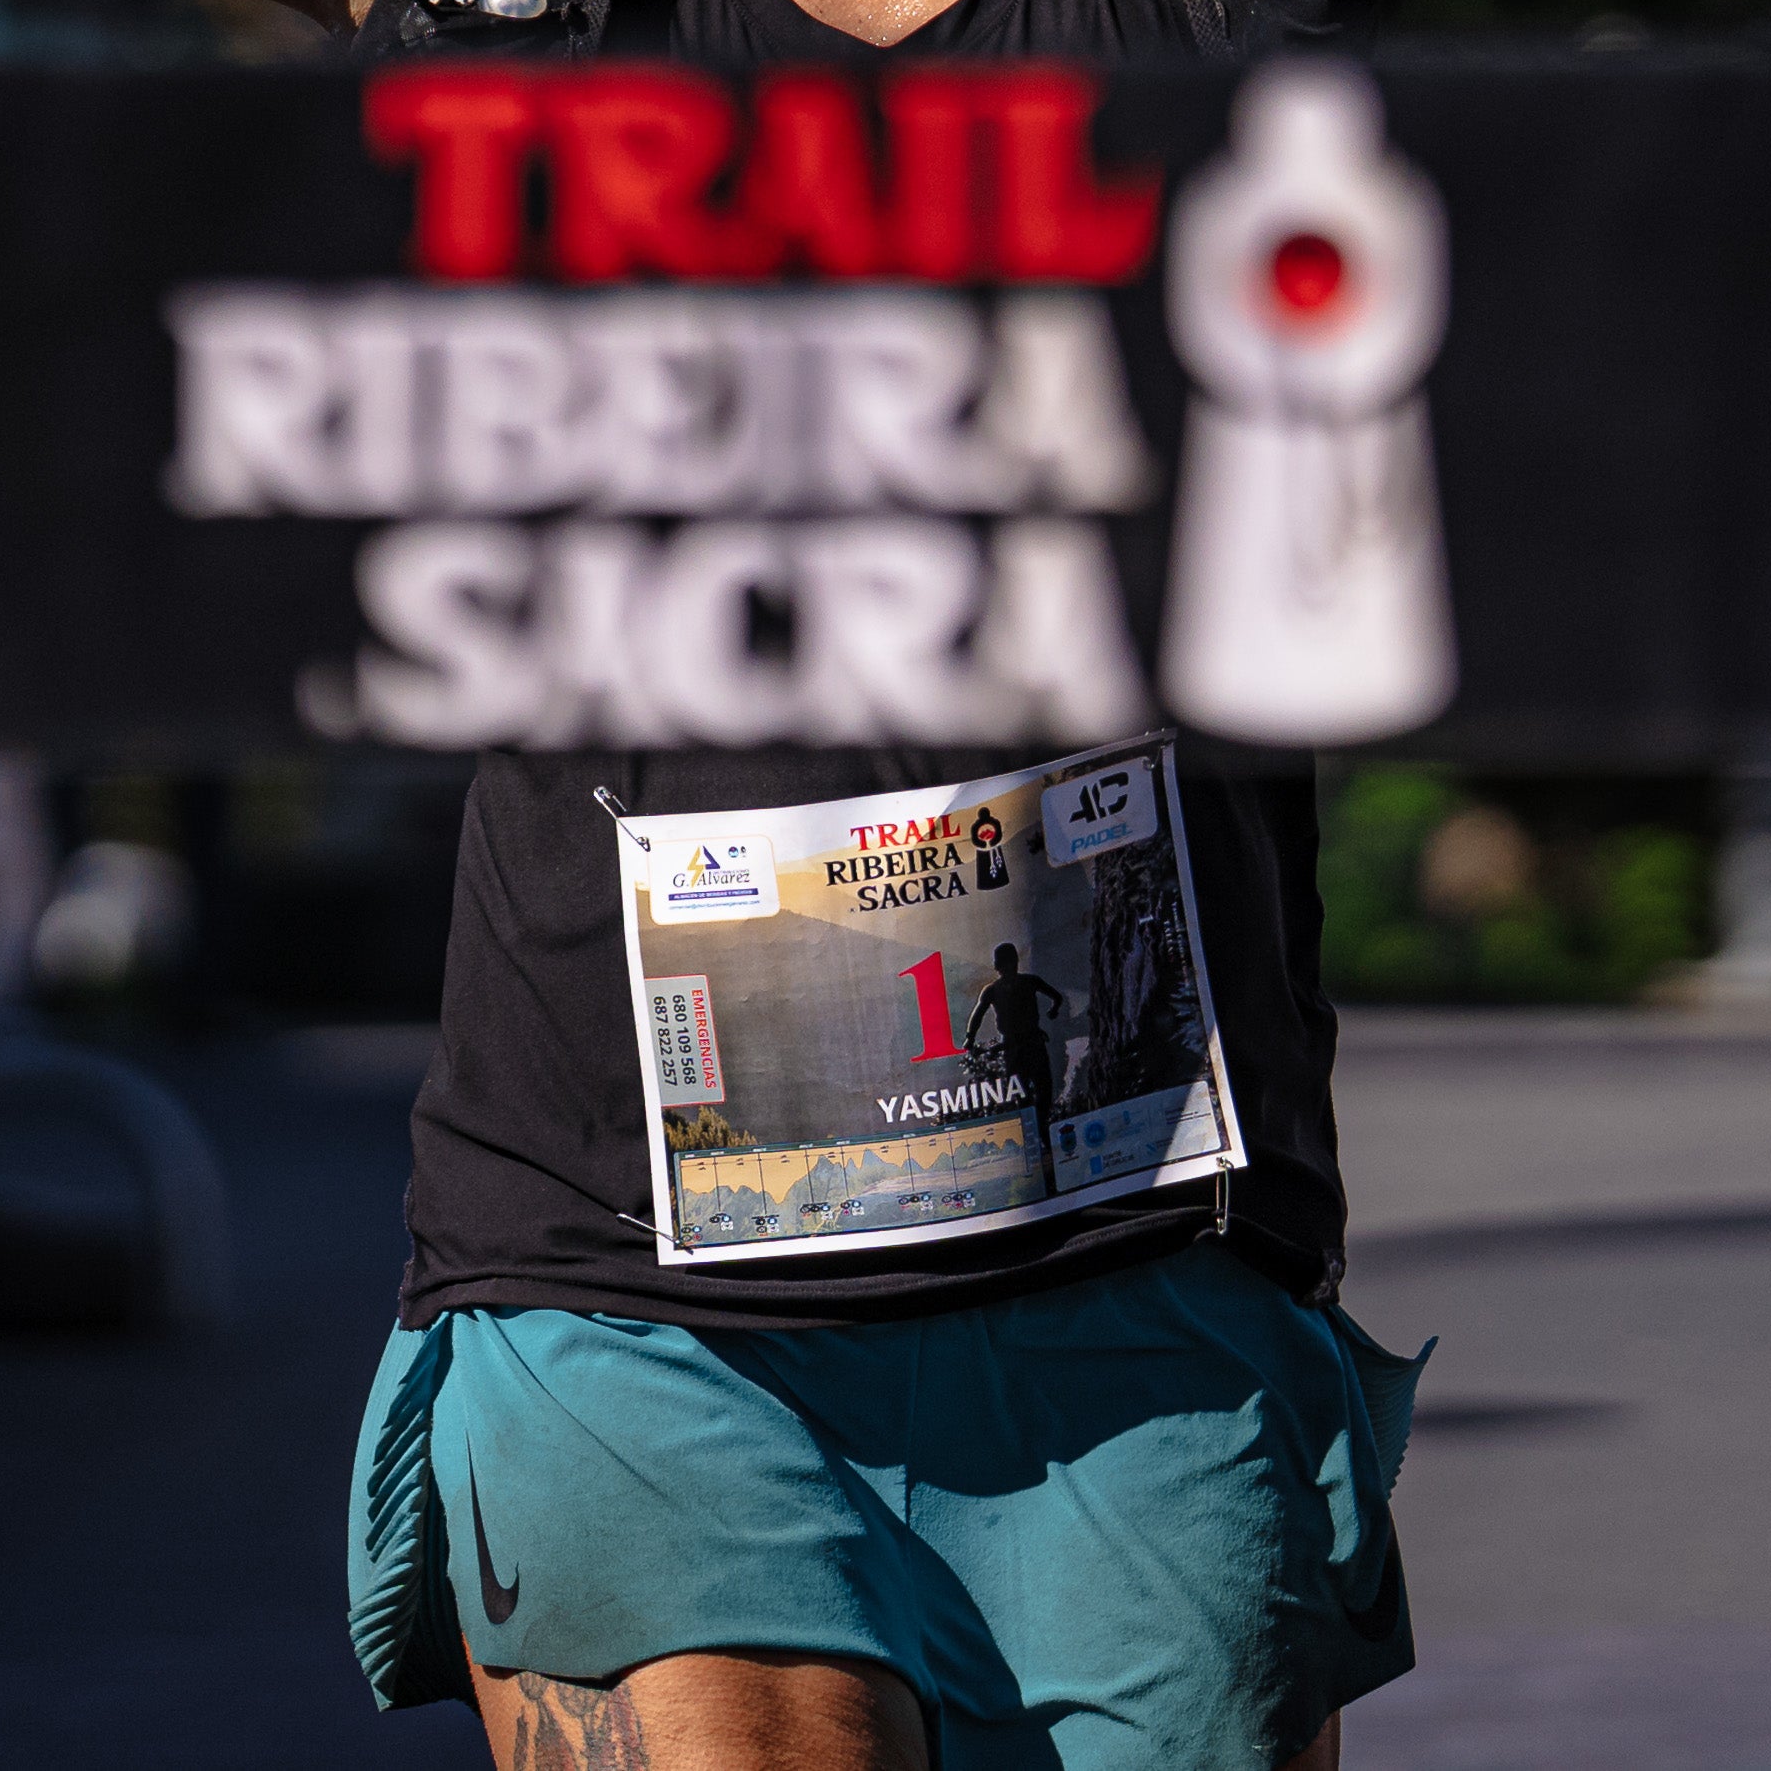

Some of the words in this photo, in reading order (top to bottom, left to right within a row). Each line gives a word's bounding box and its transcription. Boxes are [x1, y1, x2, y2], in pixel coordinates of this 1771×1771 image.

[361, 63, 1164, 283] TRAIL
[164, 285, 1152, 516] RIBEIRA
[352, 516, 1152, 750] SACRA
[850, 814, 961, 851] TRAIL
[1071, 823, 1132, 853] PADEL
[824, 843, 964, 886] RIBEIRA
[857, 872, 969, 912] SACRA
[654, 996, 668, 1023] 687
[672, 995, 687, 1022] 680
[898, 951, 969, 1063] 1
[658, 1028, 673, 1055] 822
[677, 1027, 692, 1054] 109
[692, 989, 716, 1089] EMERGENCIAS
[662, 1059, 678, 1086] 257
[681, 1057, 696, 1085] 568
[876, 1074, 1026, 1124] YASMINA
